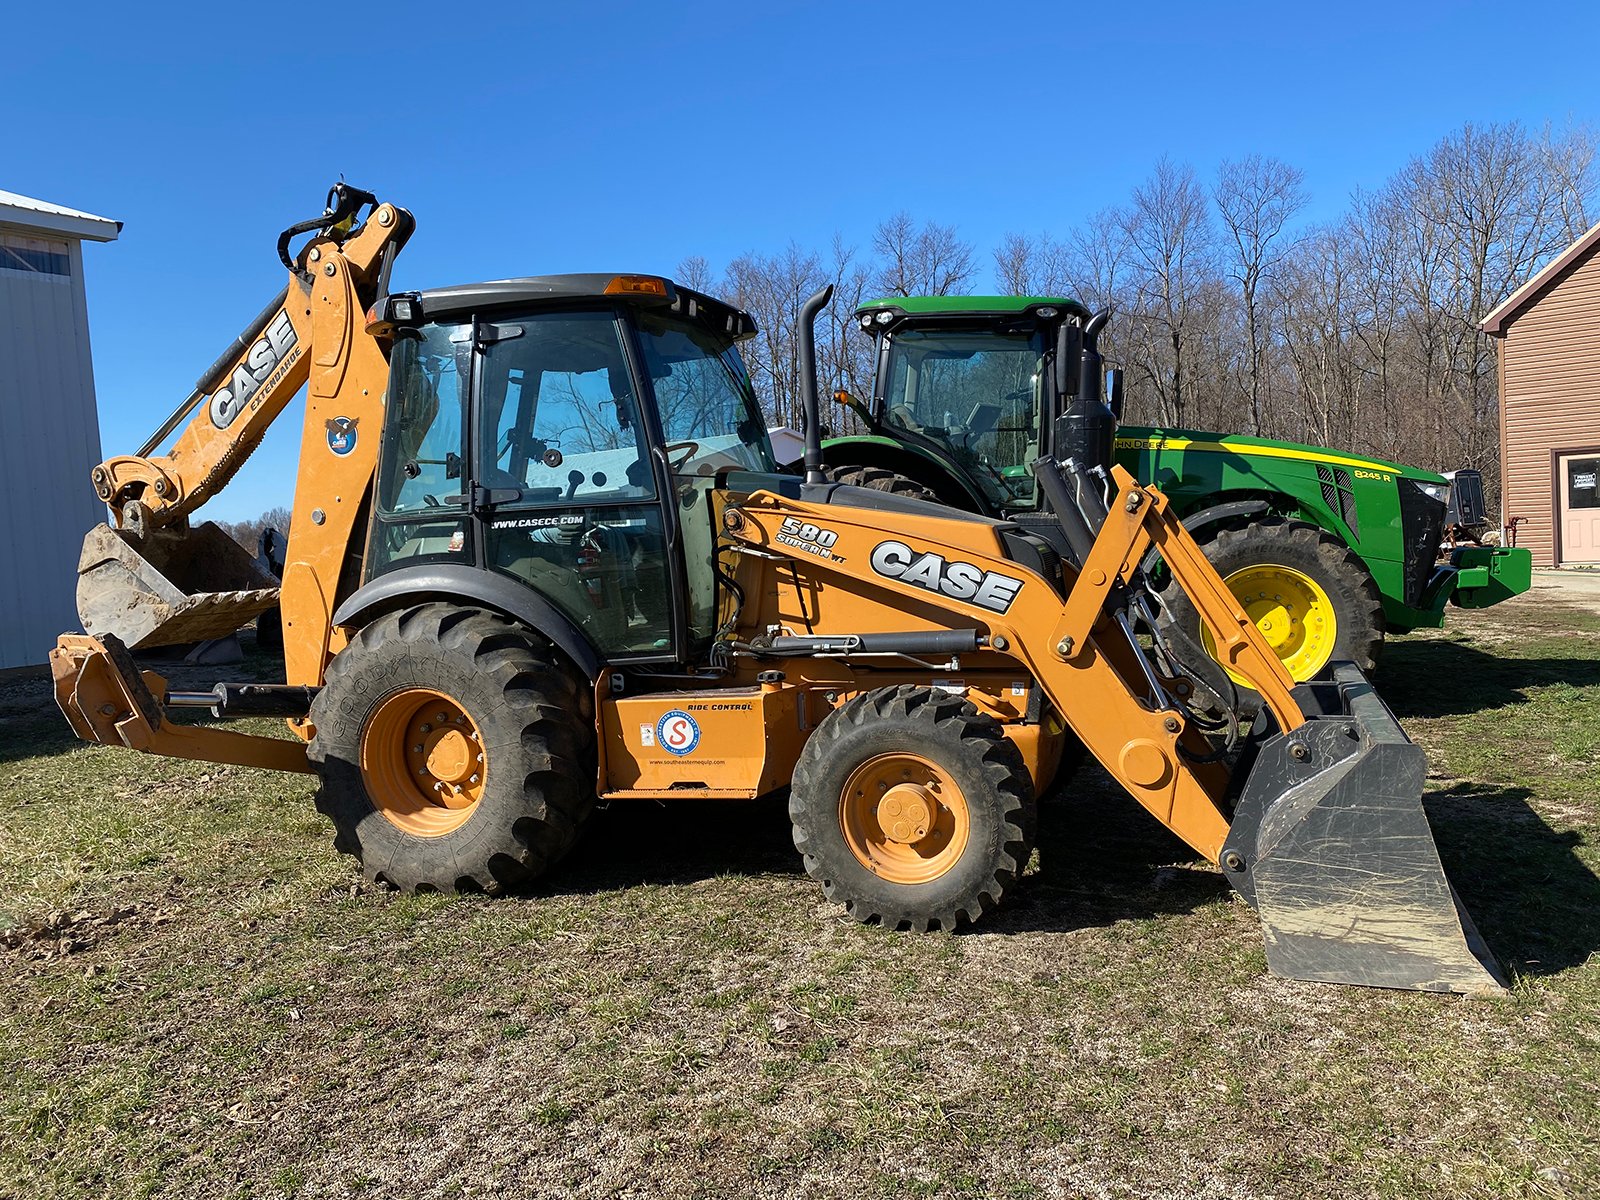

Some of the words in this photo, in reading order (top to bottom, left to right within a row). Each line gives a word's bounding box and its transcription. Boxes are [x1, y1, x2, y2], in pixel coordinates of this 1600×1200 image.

[209, 308, 299, 429] CASE
[250, 346, 302, 411] EXTENDAHOE
[1134, 440, 1169, 449] DEERE
[1354, 470, 1381, 481] 8245
[1382, 474, 1392, 483] R
[780, 516, 839, 548] 580
[775, 533, 820, 555] SUPER
[819, 547, 832, 559] N
[831, 554, 847, 564] WT
[870, 540, 1023, 613] CASE
[669, 720, 687, 745] S
